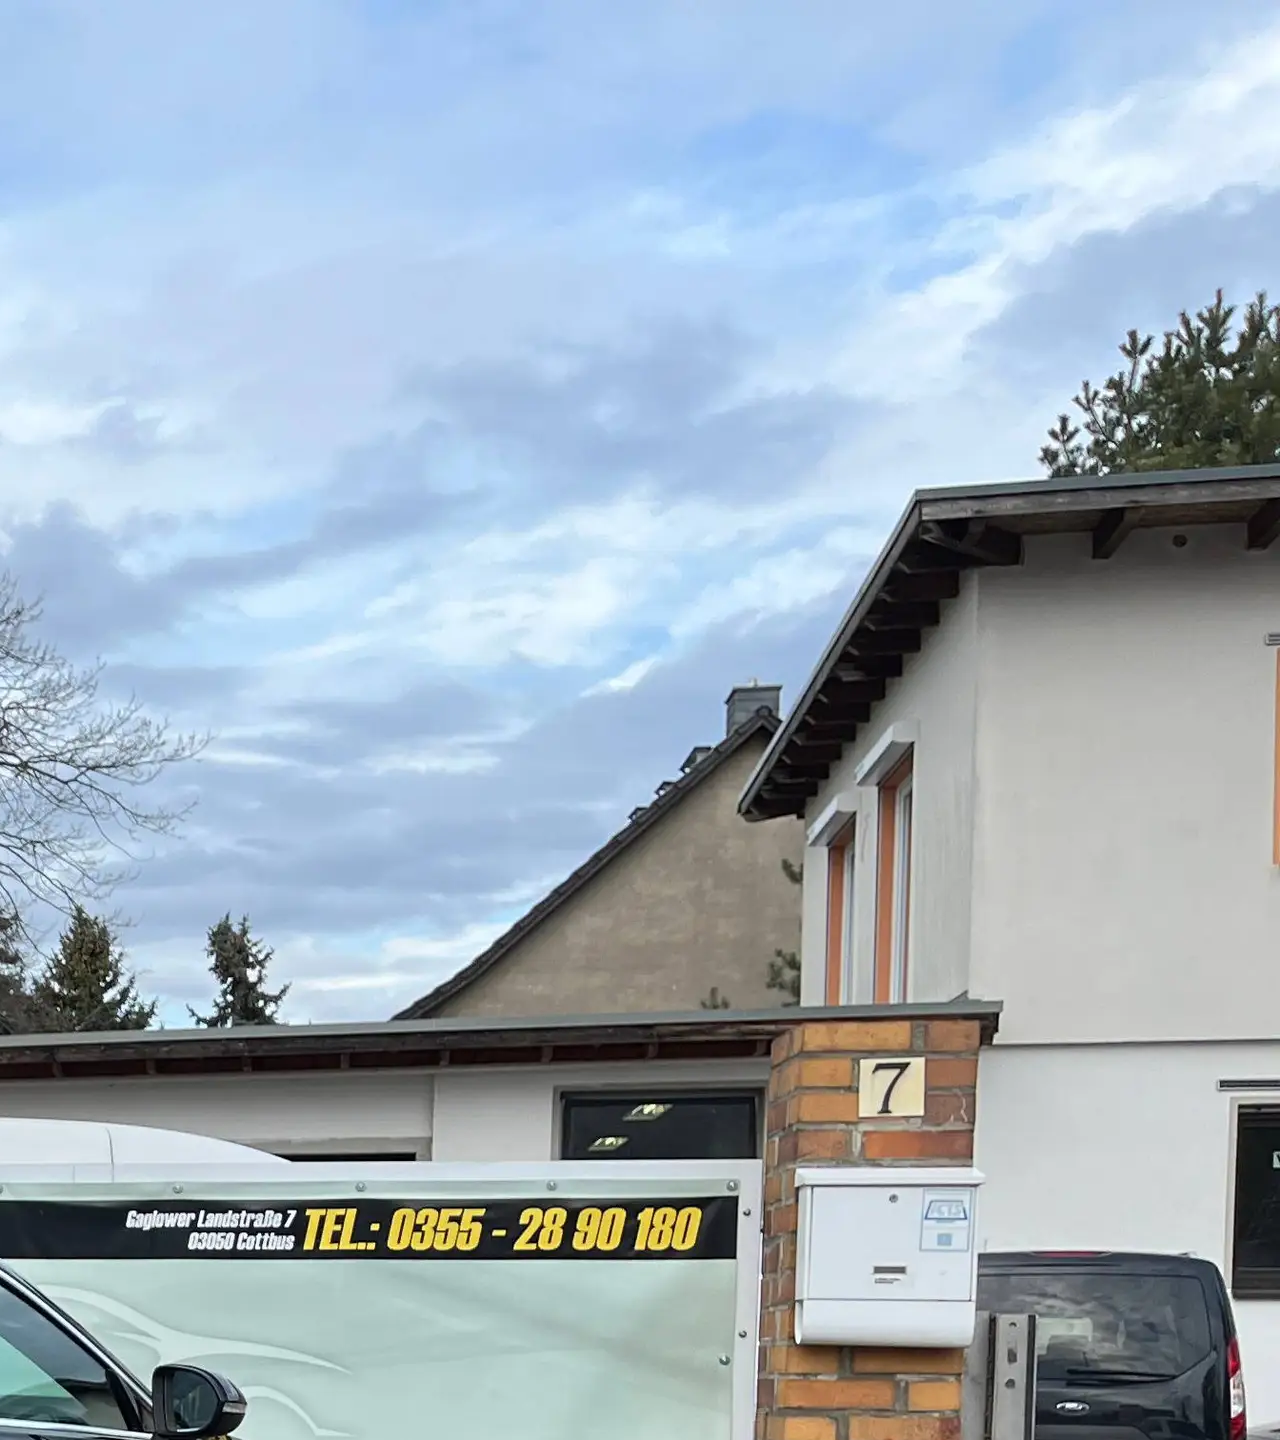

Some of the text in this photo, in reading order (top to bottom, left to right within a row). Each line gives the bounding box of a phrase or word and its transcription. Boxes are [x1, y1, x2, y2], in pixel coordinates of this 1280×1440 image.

[871, 1062, 911, 1115] 7
[125, 1209, 297, 1231] Gaglower Landstraße 7
[303, 1208, 381, 1250] TEL.:
[387, 1208, 487, 1251] 0355
[513, 1207, 569, 1251] 28
[572, 1207, 627, 1251] 90
[634, 1207, 703, 1251] 180
[188, 1232, 295, 1250] 03050 Cottbus
